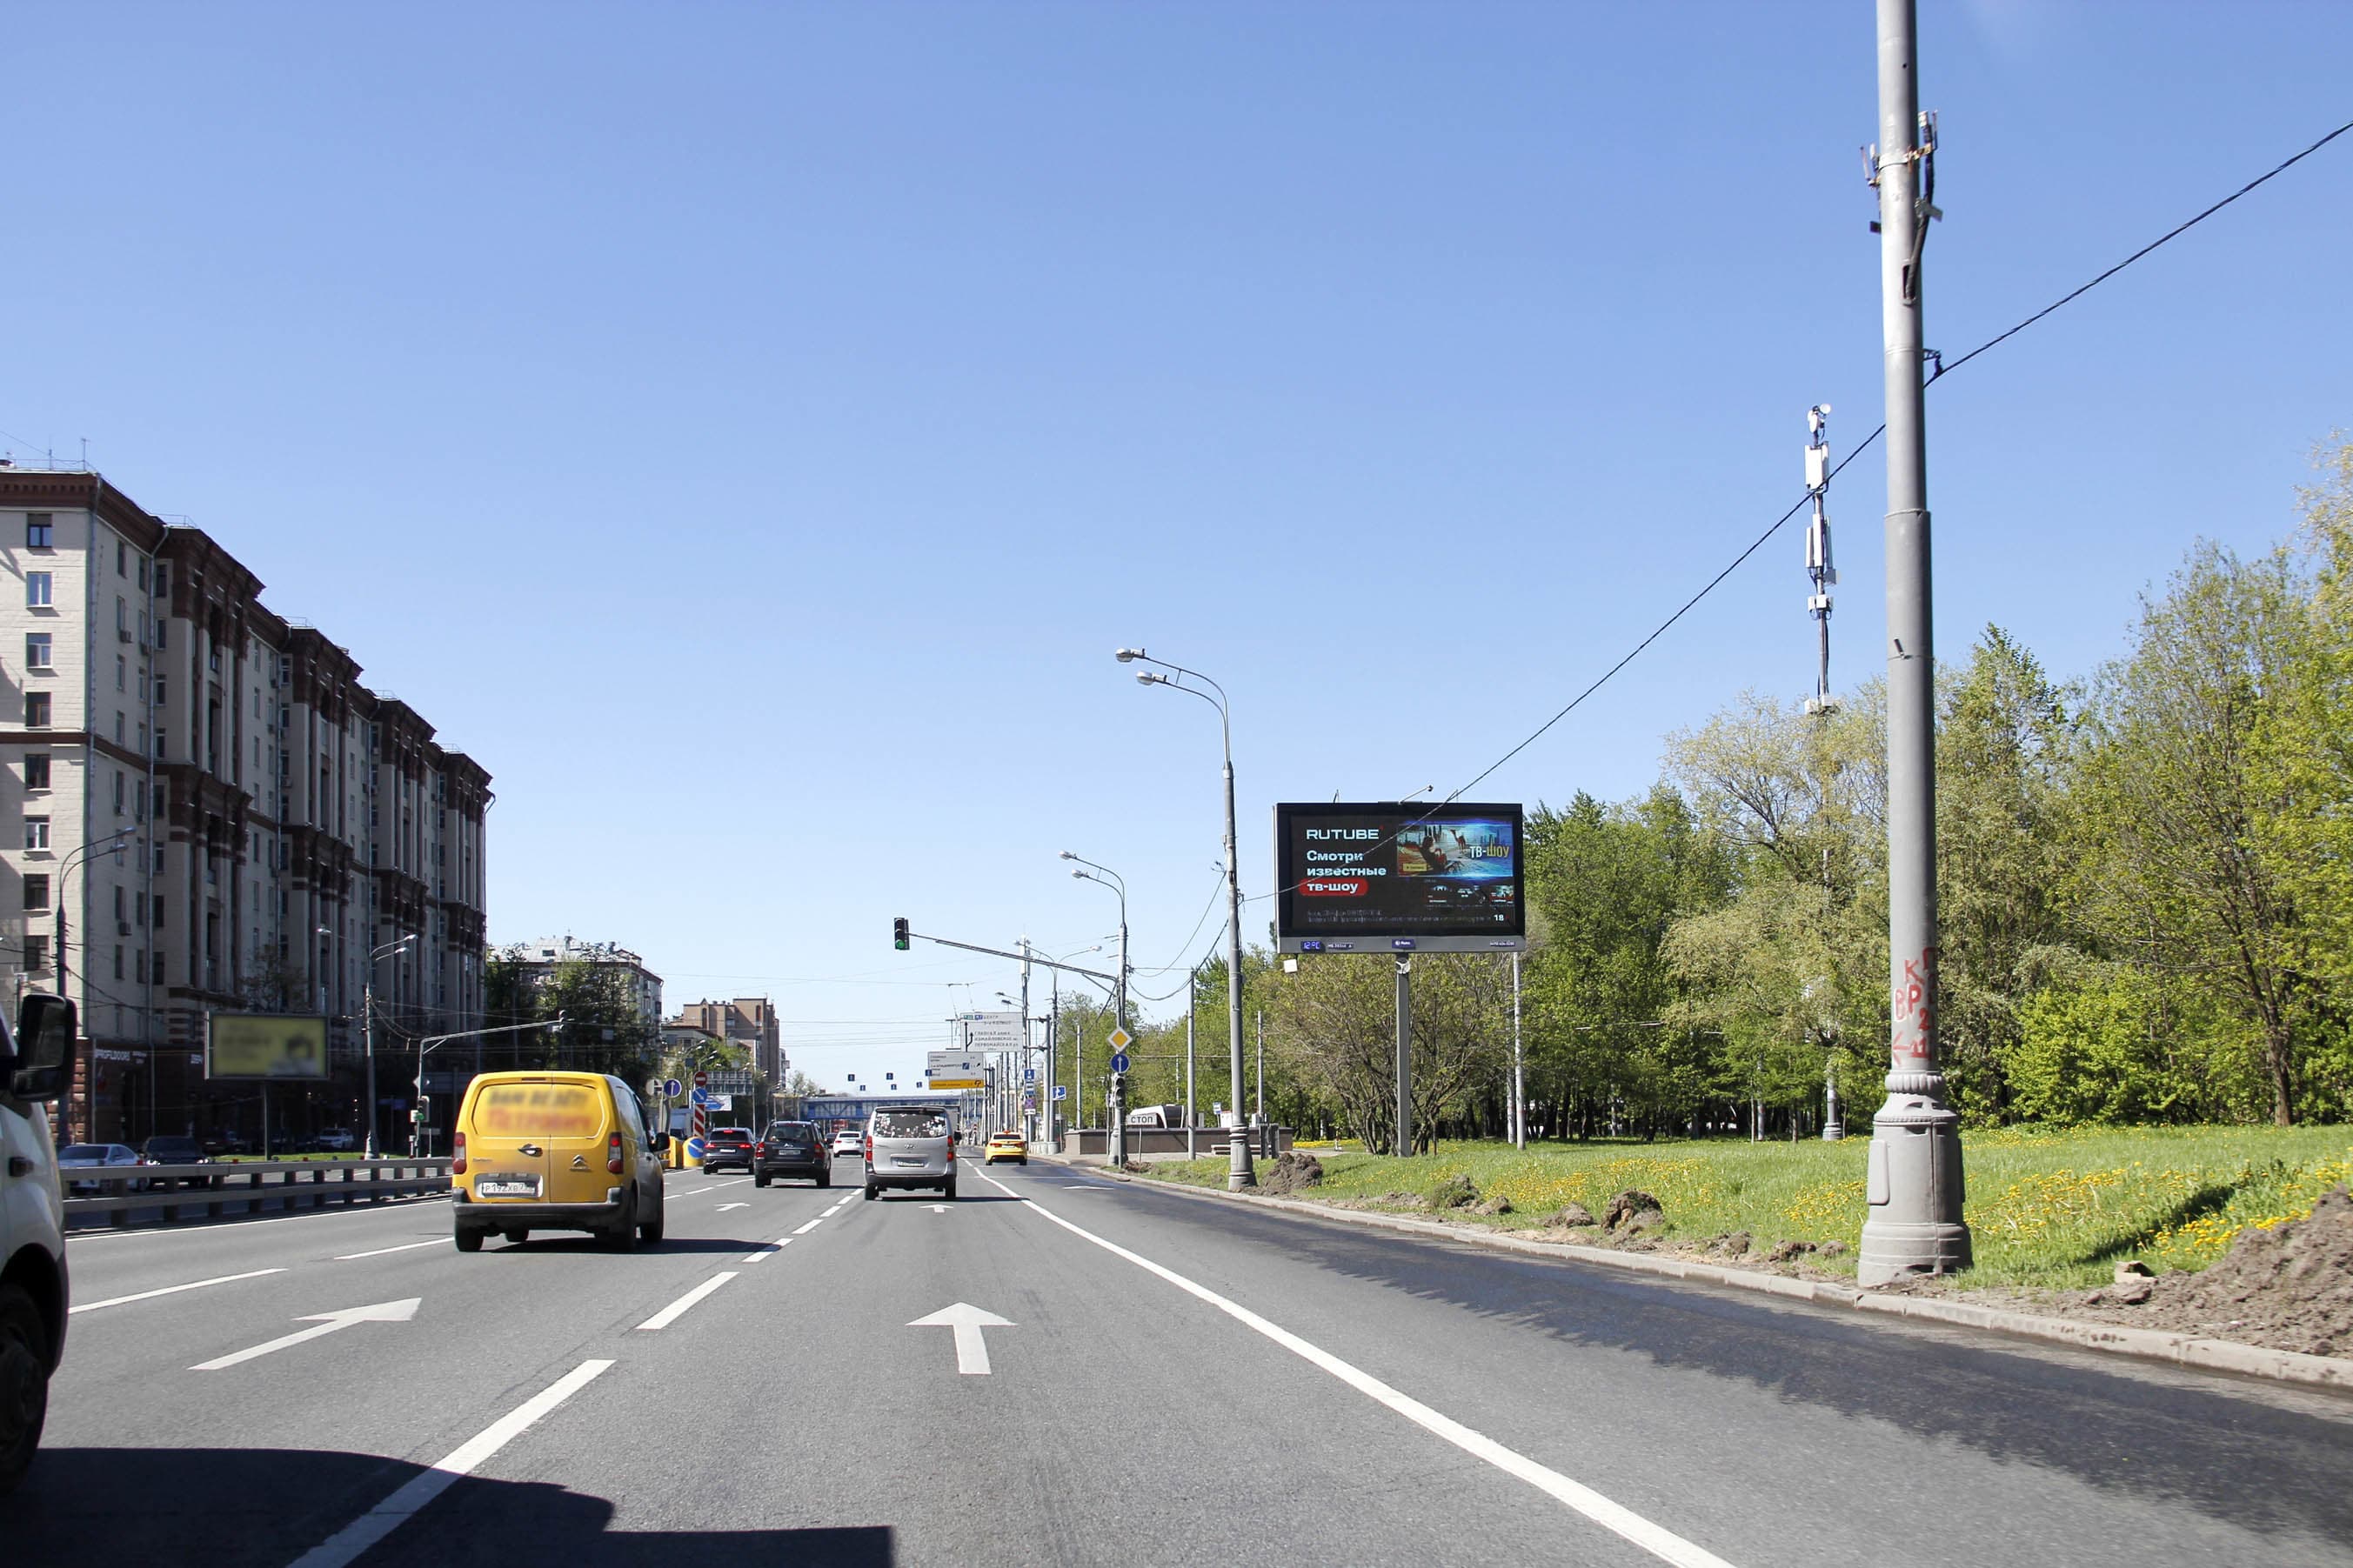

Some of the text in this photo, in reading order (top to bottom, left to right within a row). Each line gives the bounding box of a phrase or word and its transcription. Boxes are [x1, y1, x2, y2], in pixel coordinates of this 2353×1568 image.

[1306, 829, 1380, 840] RUTUBE
[1307, 850, 1364, 864] Смотри
[1307, 867, 1387, 877] известные
[1307, 883, 1359, 894] тв-шоу
